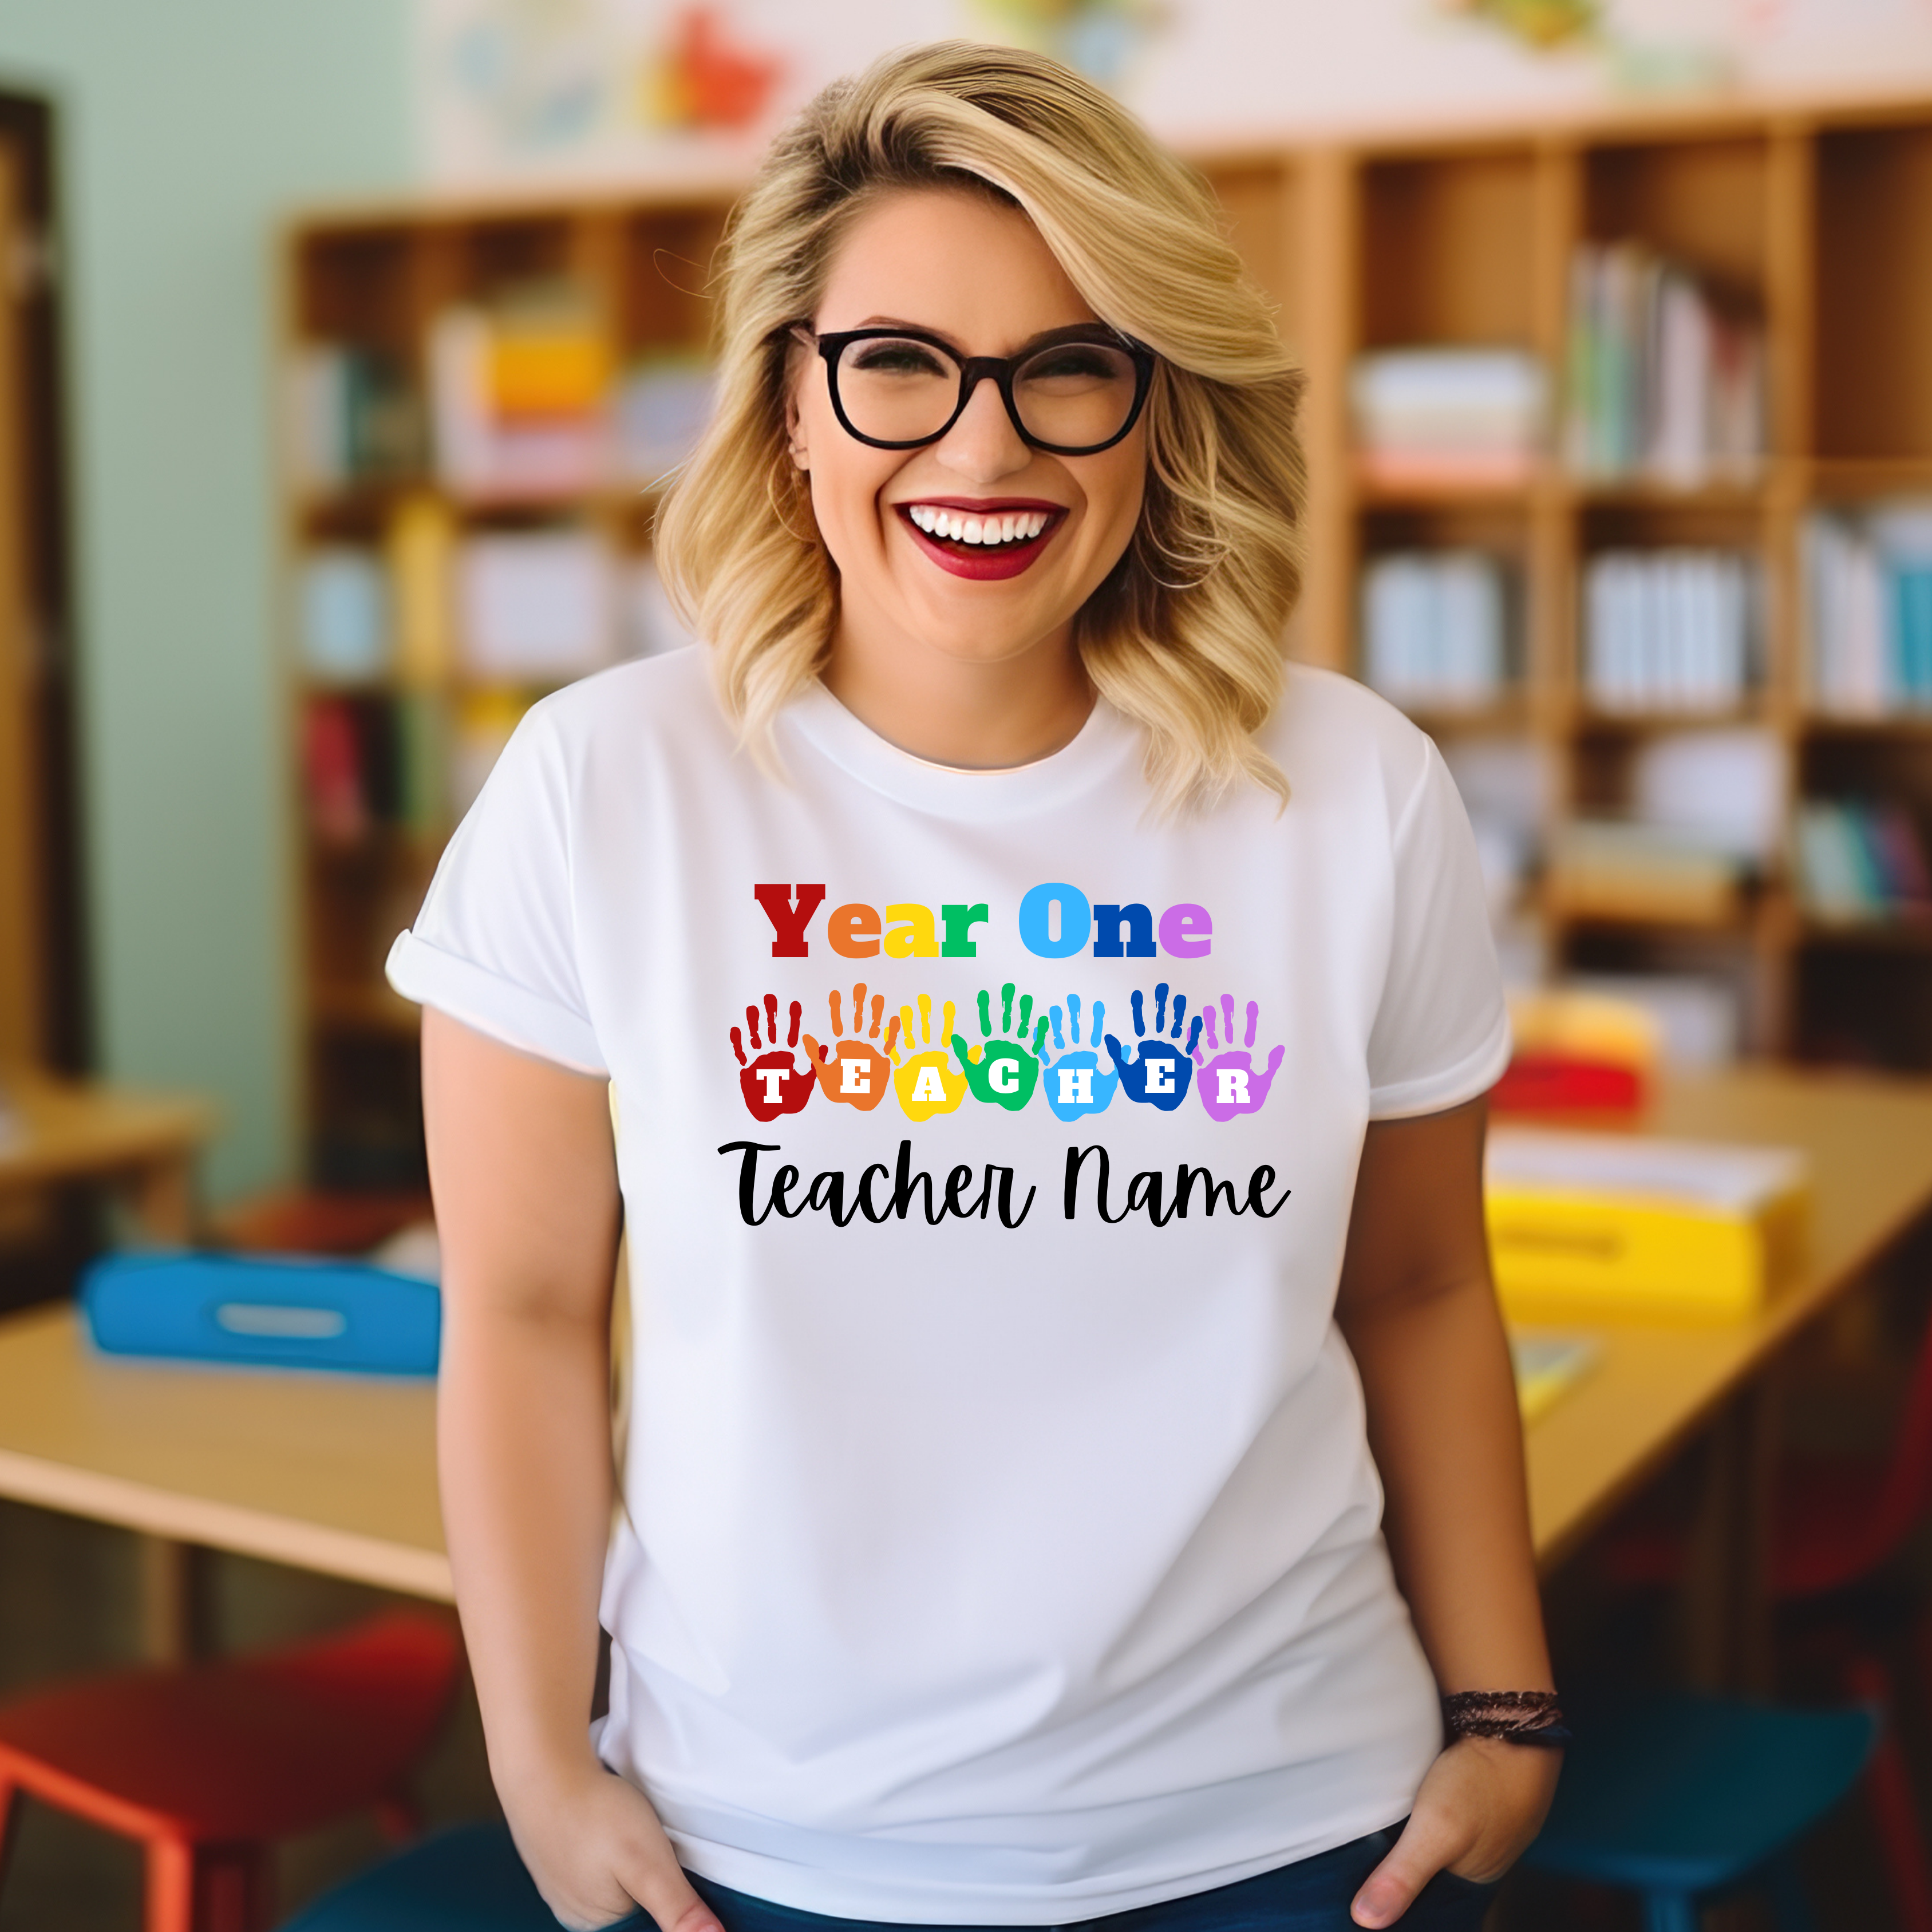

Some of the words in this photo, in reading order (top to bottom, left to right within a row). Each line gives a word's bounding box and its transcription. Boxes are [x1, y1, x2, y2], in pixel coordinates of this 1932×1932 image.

[754, 884, 989, 958] Year
[1019, 883, 1212, 959] One
[757, 1058, 1250, 1104] TEACHER
[718, 1140, 1037, 1228] Teacher
[1064, 1145, 1291, 1227] Name
